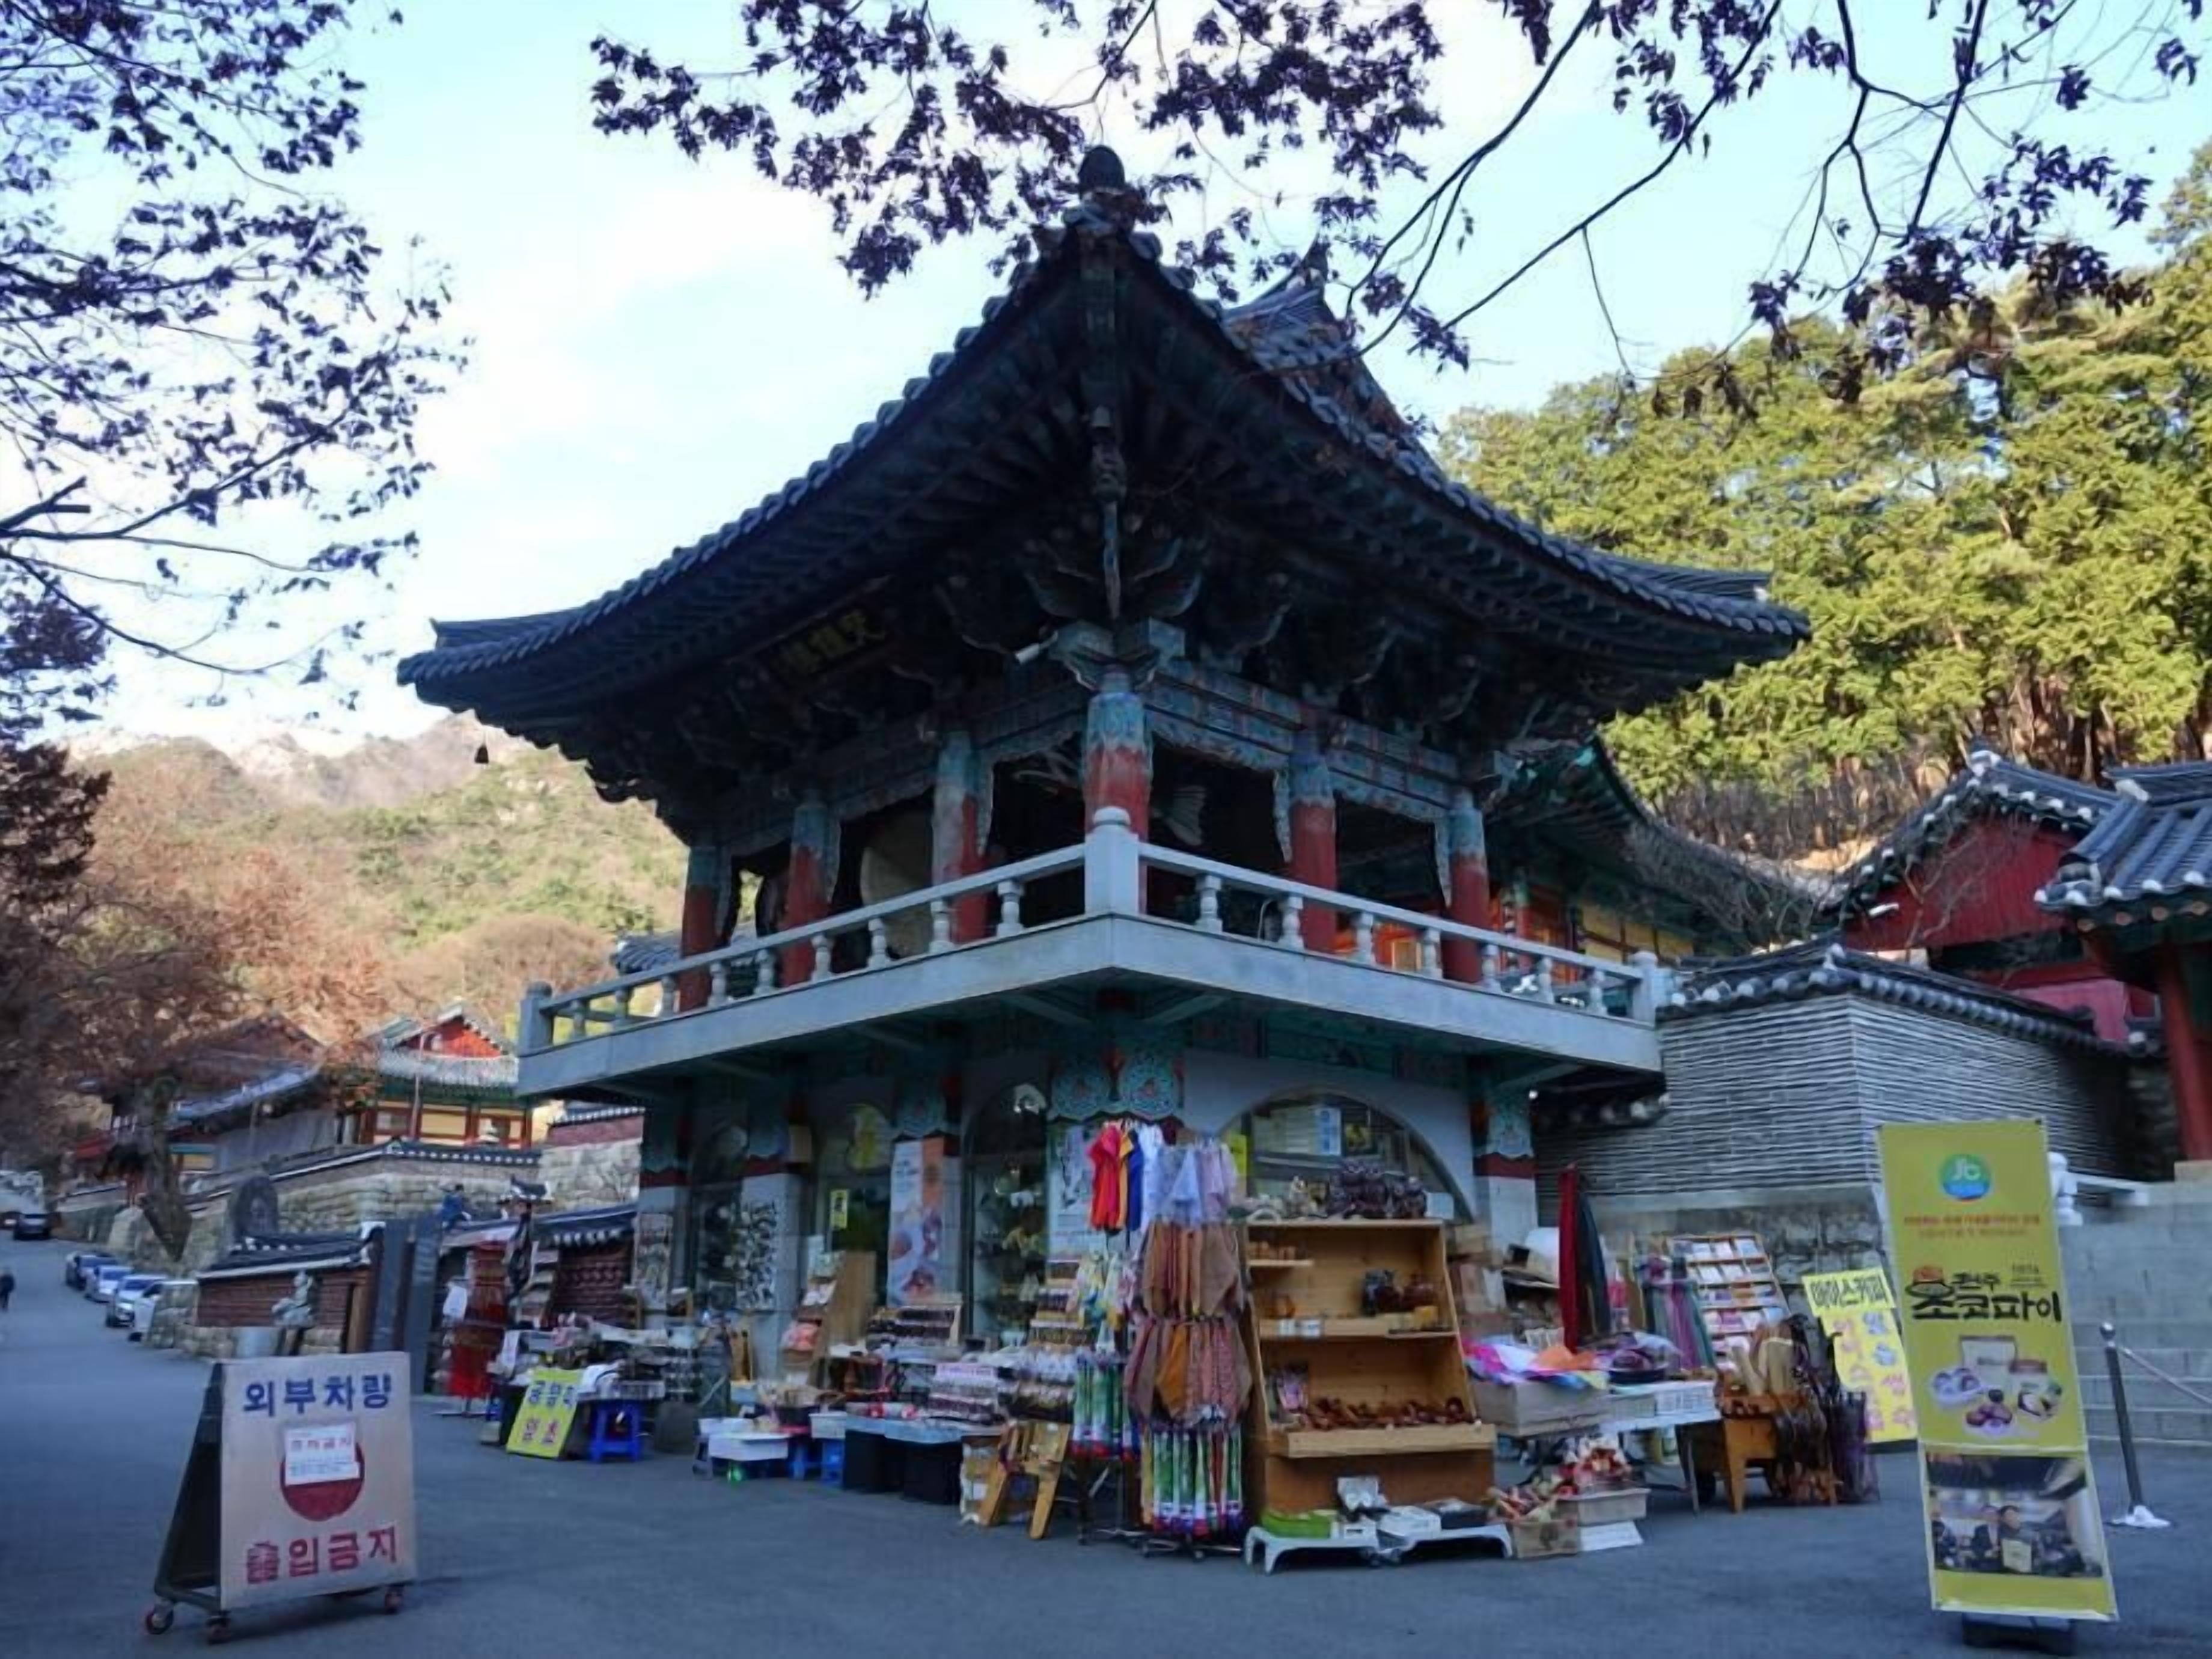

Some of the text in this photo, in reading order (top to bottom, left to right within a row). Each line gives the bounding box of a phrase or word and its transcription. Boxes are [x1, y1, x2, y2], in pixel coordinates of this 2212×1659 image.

[1907, 1283, 2062, 1322] 초코파이
[243, 1373, 392, 1417] 외부차량
[246, 1526, 397, 1584] 출입금지
